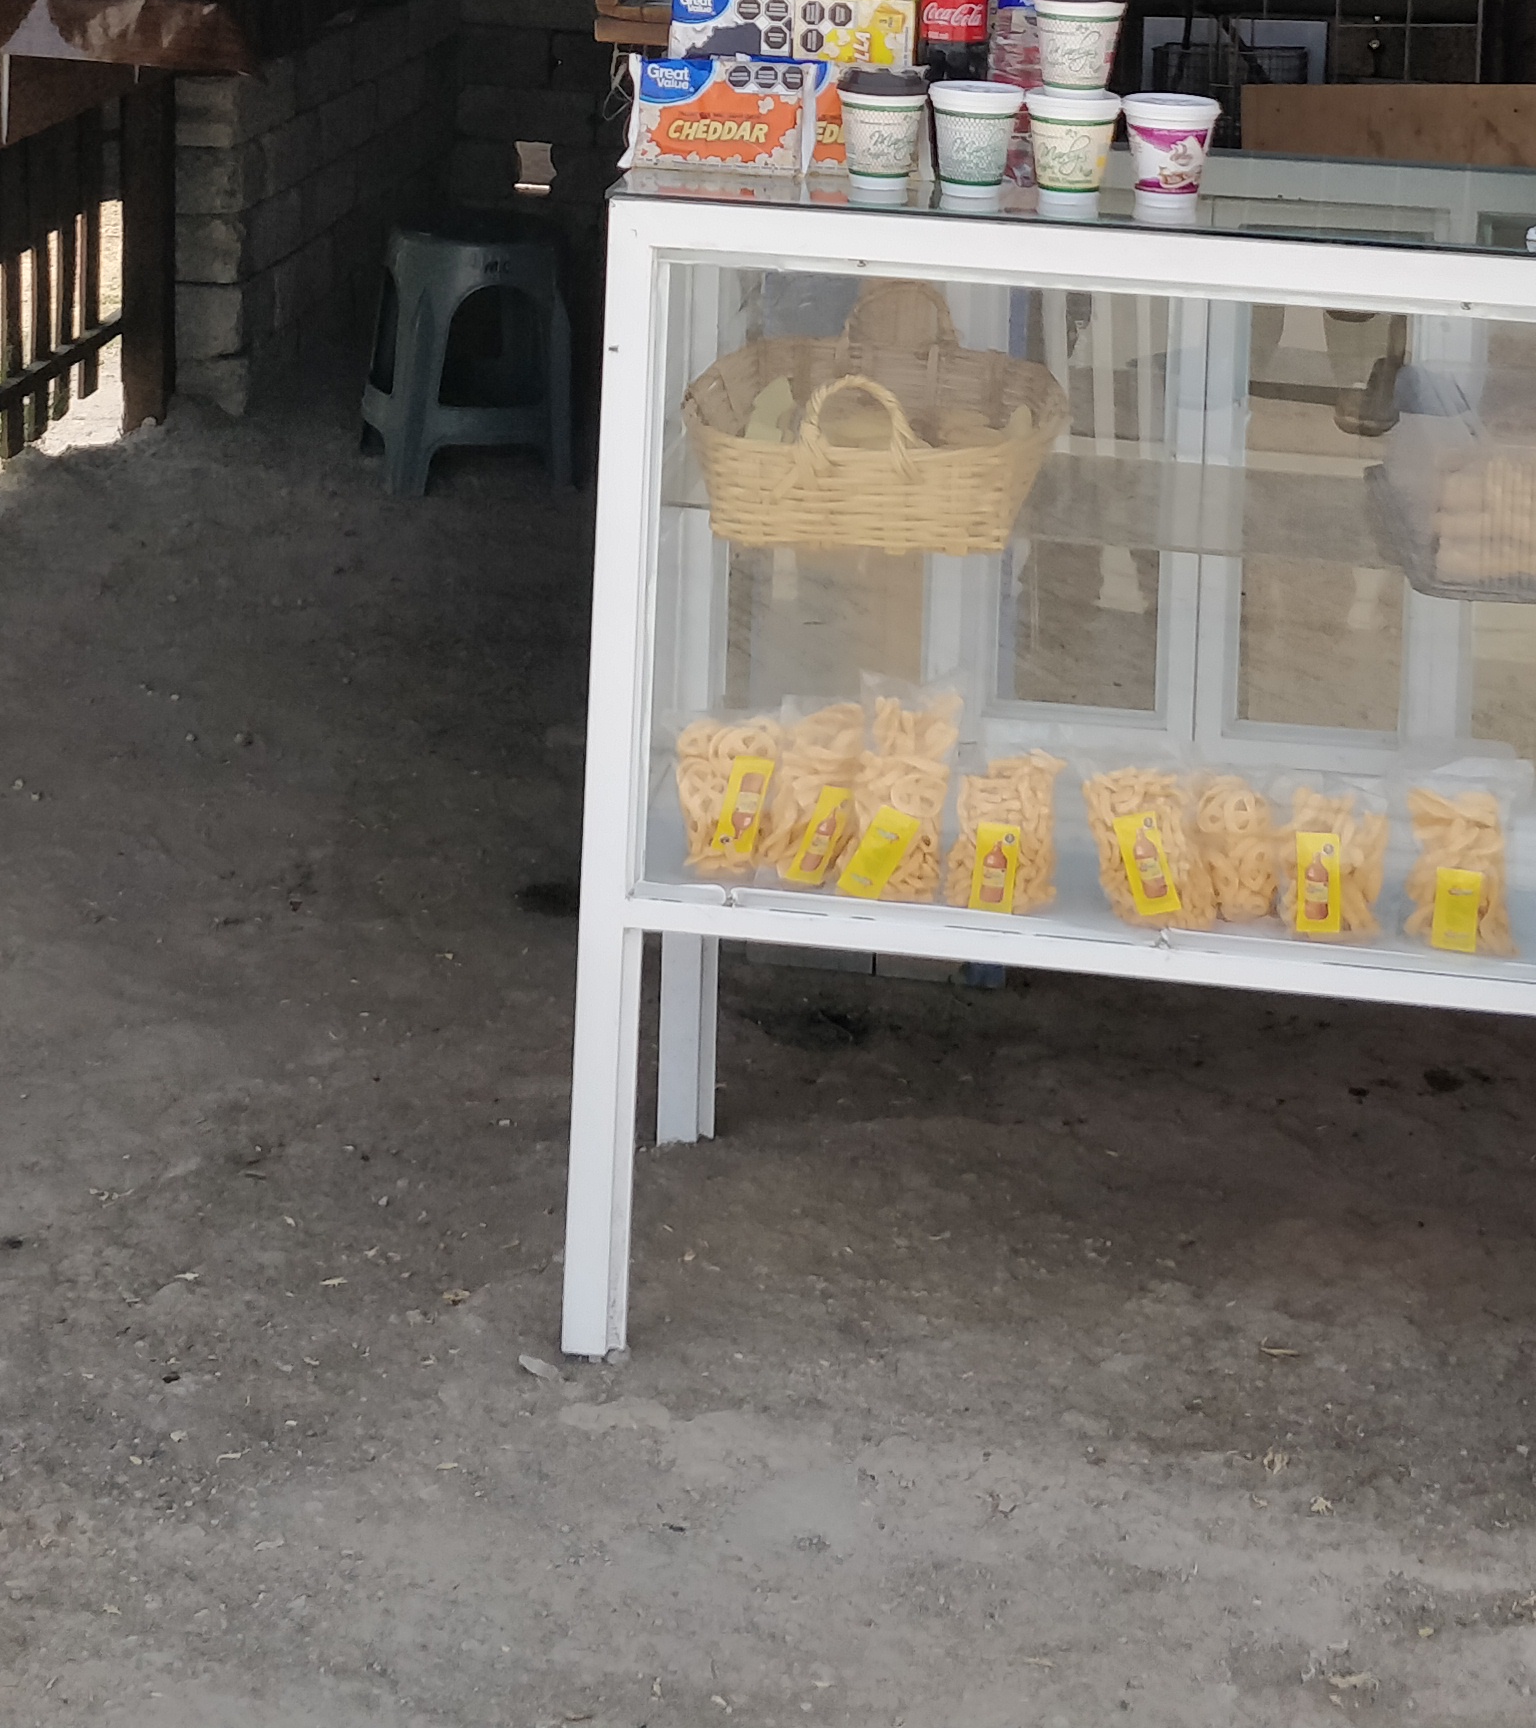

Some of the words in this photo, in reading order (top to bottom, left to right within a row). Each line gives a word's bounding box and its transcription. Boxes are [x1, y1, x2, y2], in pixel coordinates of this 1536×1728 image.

[686, 4, 713, 15] Value
[646, 63, 691, 80] Great
[655, 77, 690, 91] Value
[667, 118, 769, 144] CHEDDAR
